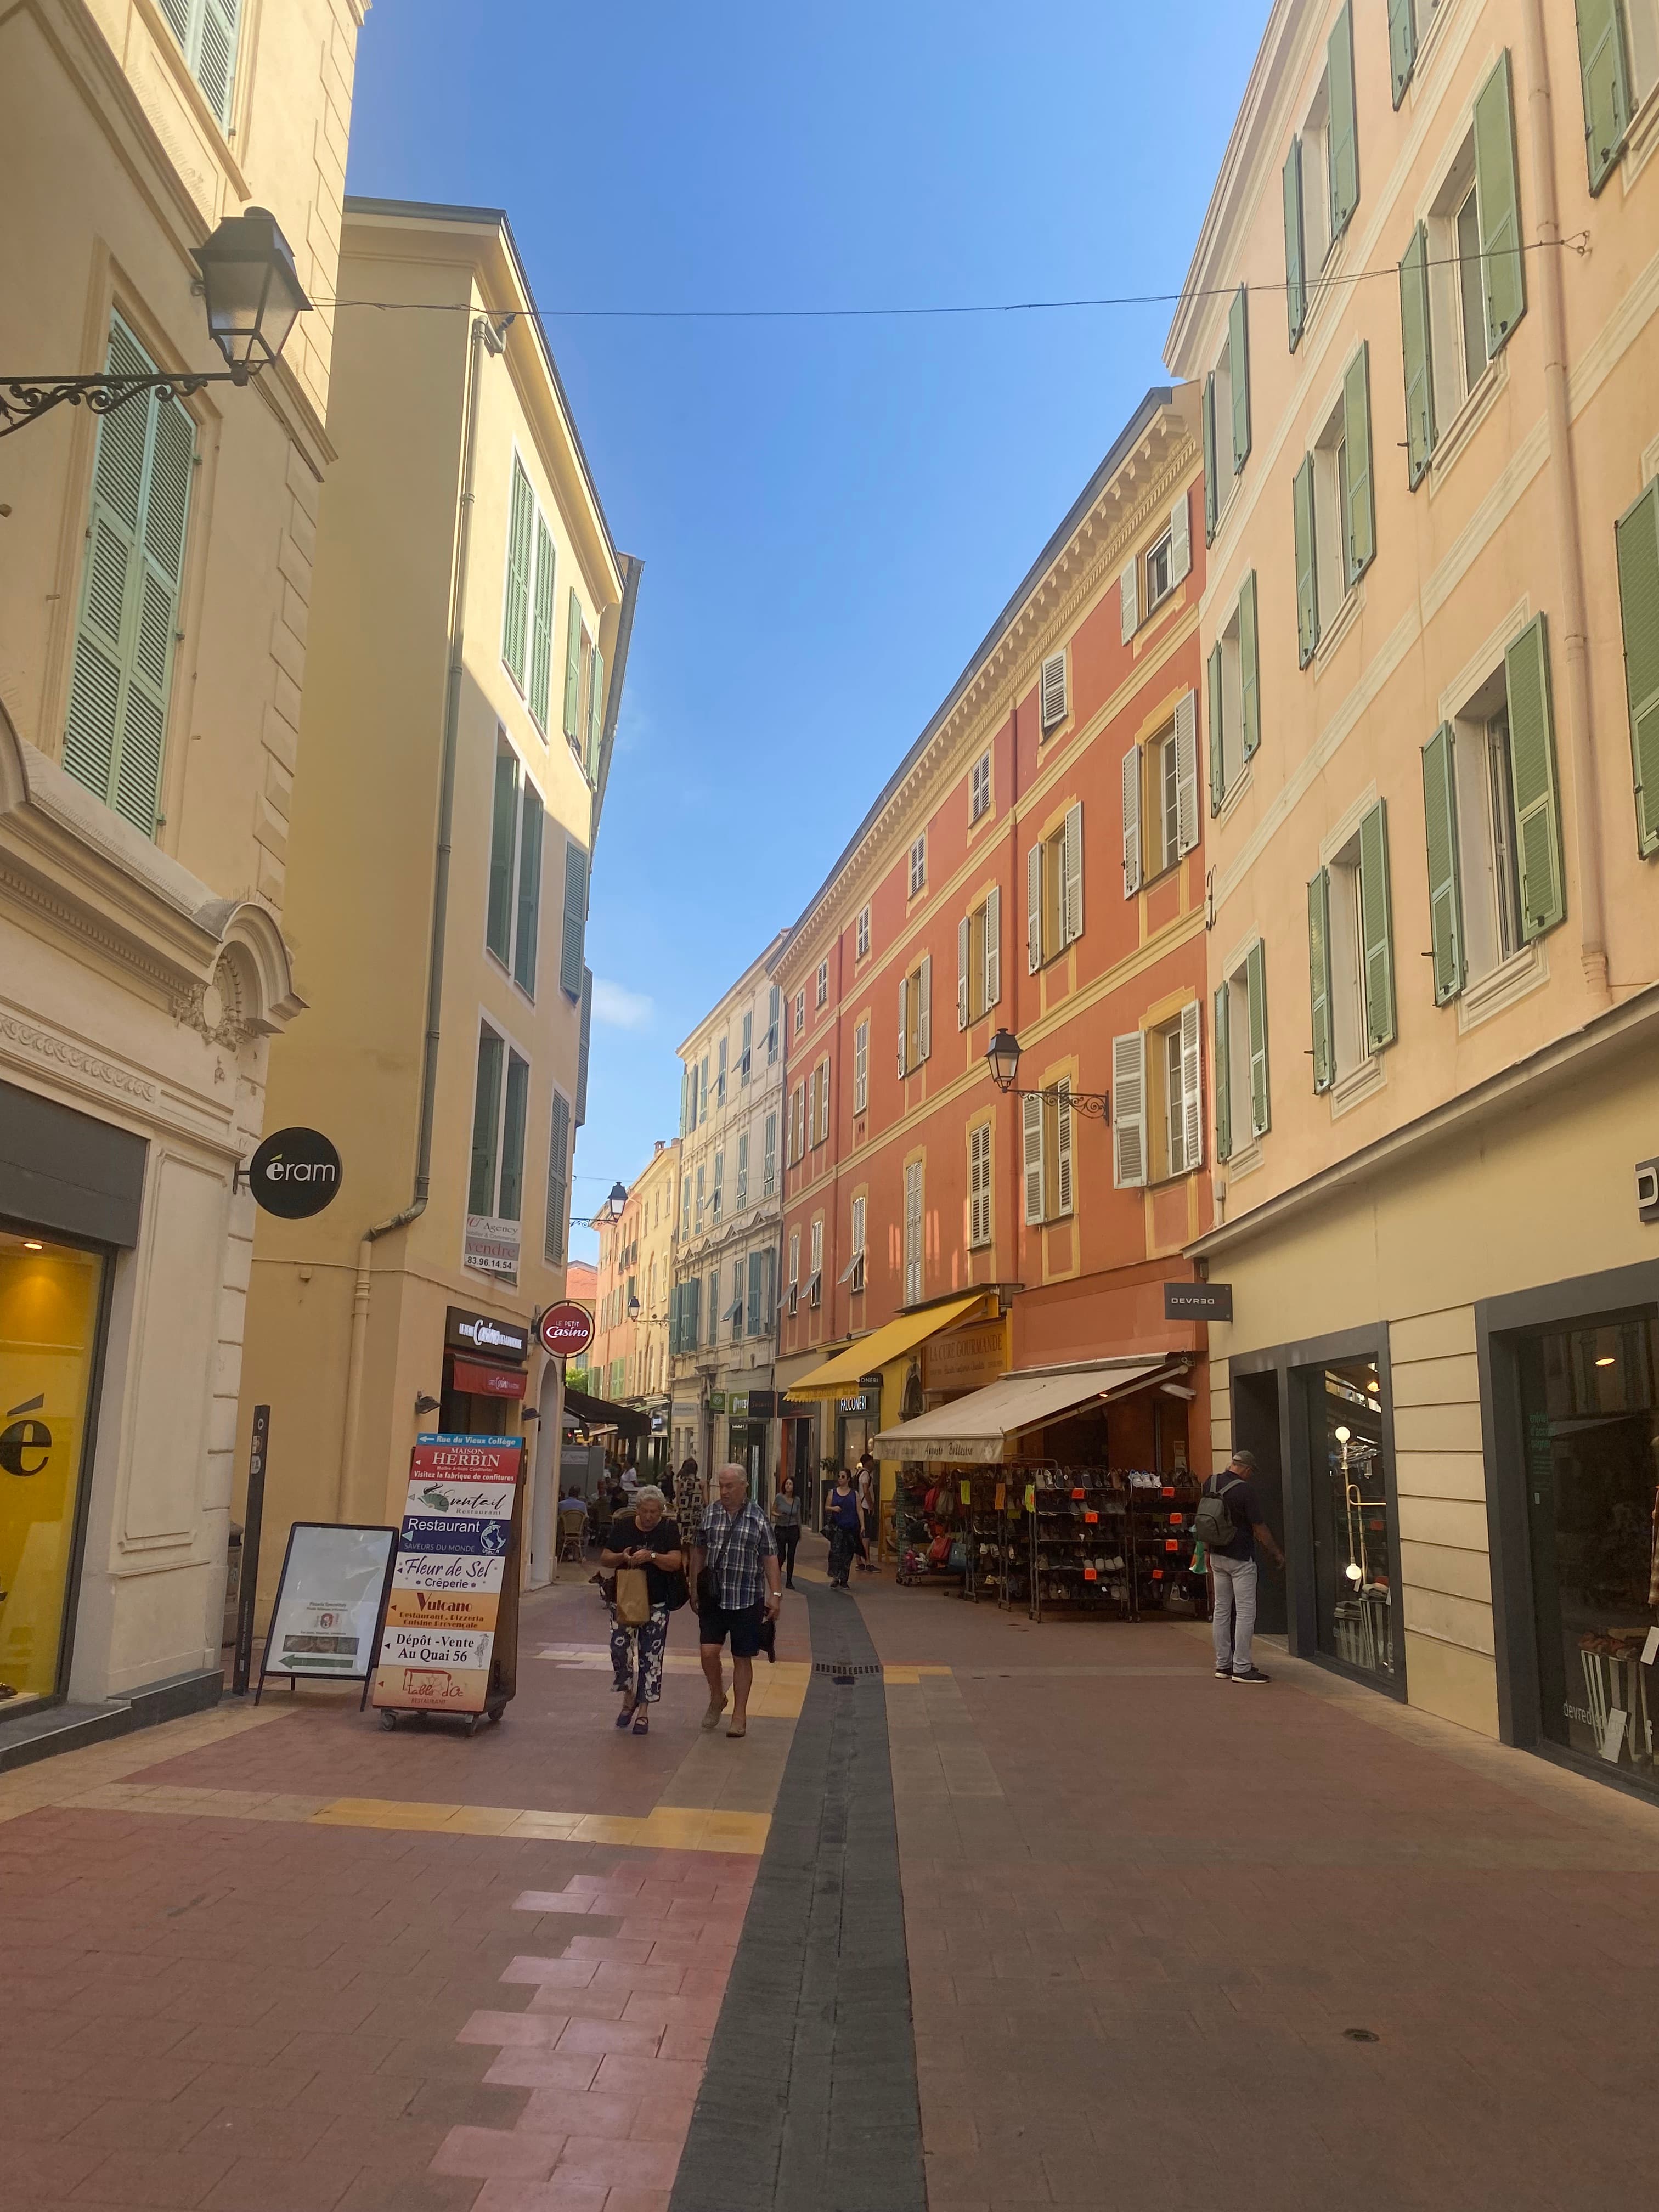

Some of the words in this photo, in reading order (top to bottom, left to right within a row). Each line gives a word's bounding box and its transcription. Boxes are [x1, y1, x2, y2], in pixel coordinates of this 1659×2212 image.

[266, 1154, 335, 1181] éram
[1634, 1167, 1658, 1209] D
[483, 1222, 518, 1235] Agency
[469, 1243, 515, 1257] vendre
[467, 1256, 512, 1269] 83.96.14.54
[546, 1326, 588, 1338] Casino
[956, 1334, 1002, 1357] GOURMANDE
[840, 1395, 867, 1412] FALCONERI
[0, 1393, 52, 1476] é
[488, 1437, 516, 1447] Collège
[432, 1452, 500, 1467] HERBIN
[408, 1518, 480, 1533] Restaurant
[405, 1555, 443, 1575] Fleur
[445, 1557, 462, 1576] de
[466, 1558, 495, 1577] Sel
[425, 1578, 468, 1589] Crêperie
[417, 1593, 472, 1612] Vulcano
[435, 1621, 477, 1629] Provençale
[396, 1634, 431, 1646] Dépôt
[398, 1647, 416, 1658] Au
[420, 1649, 449, 1662] Quai
[453, 1650, 467, 1661] 56
